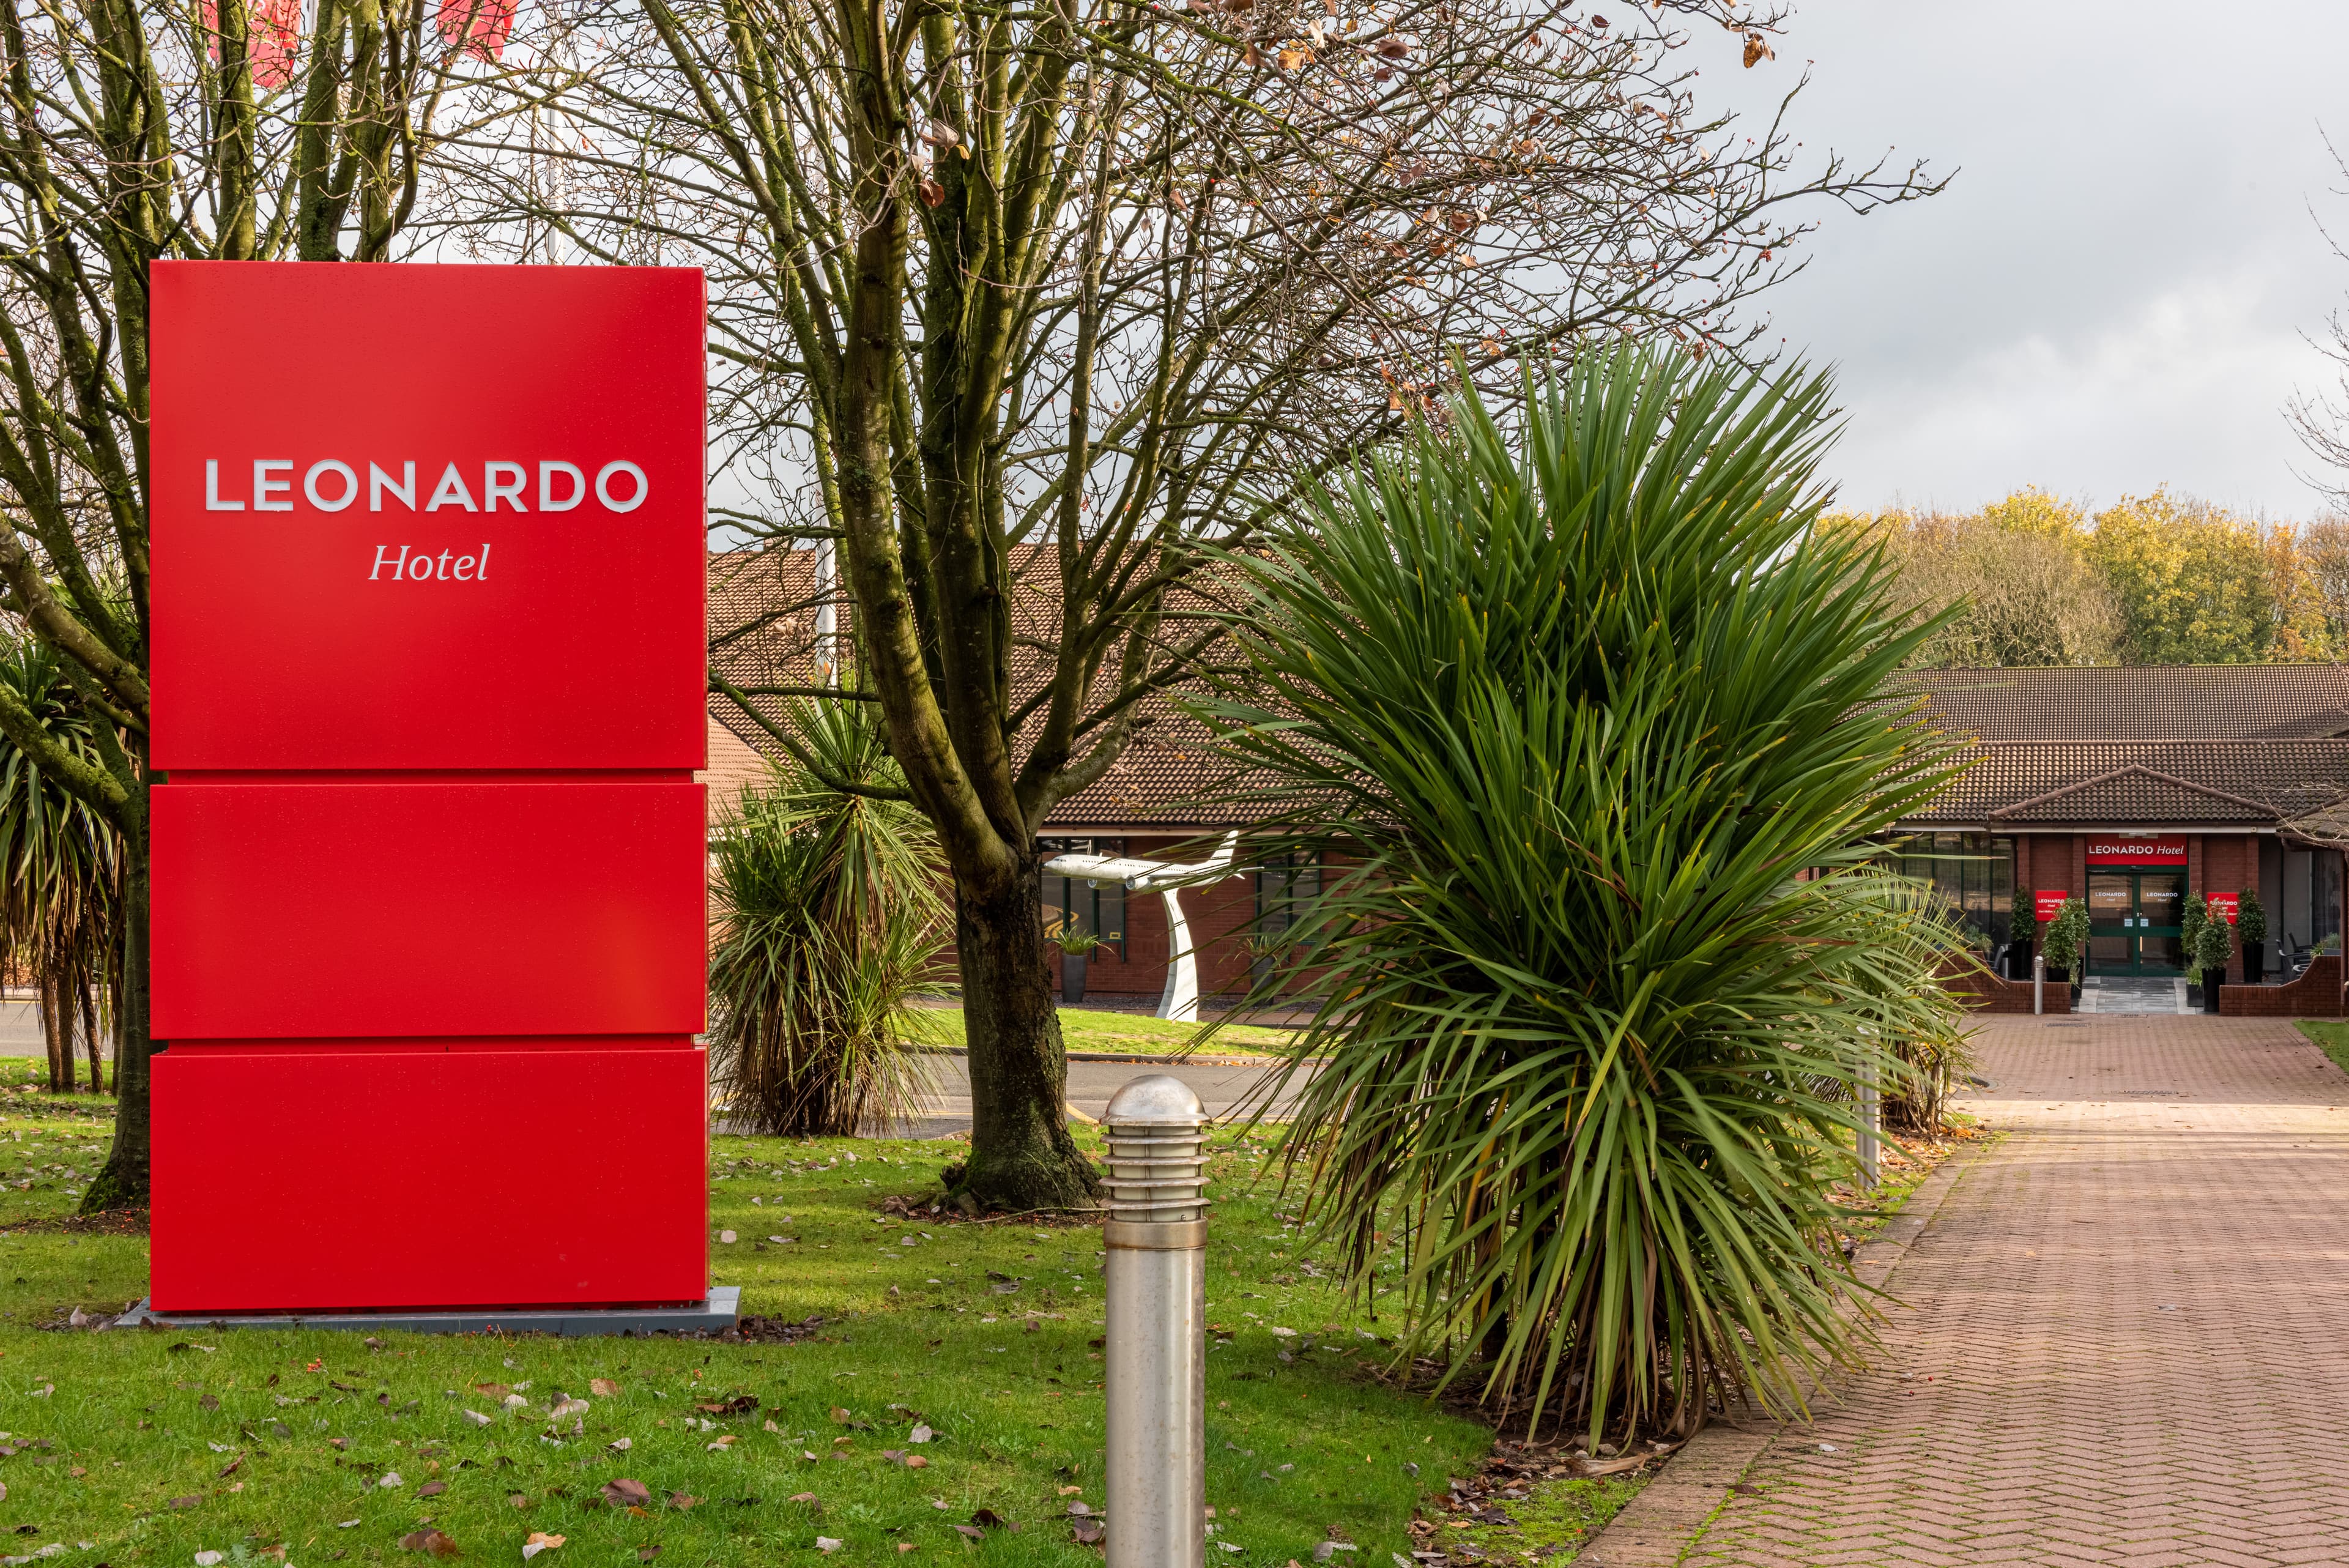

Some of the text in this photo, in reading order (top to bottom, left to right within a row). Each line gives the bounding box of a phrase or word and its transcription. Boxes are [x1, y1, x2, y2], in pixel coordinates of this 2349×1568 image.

[206, 459, 648, 513] LEONARDO
[368, 543, 491, 582] Hotel
[2088, 845, 2184, 855] LEONARDO Hotel
